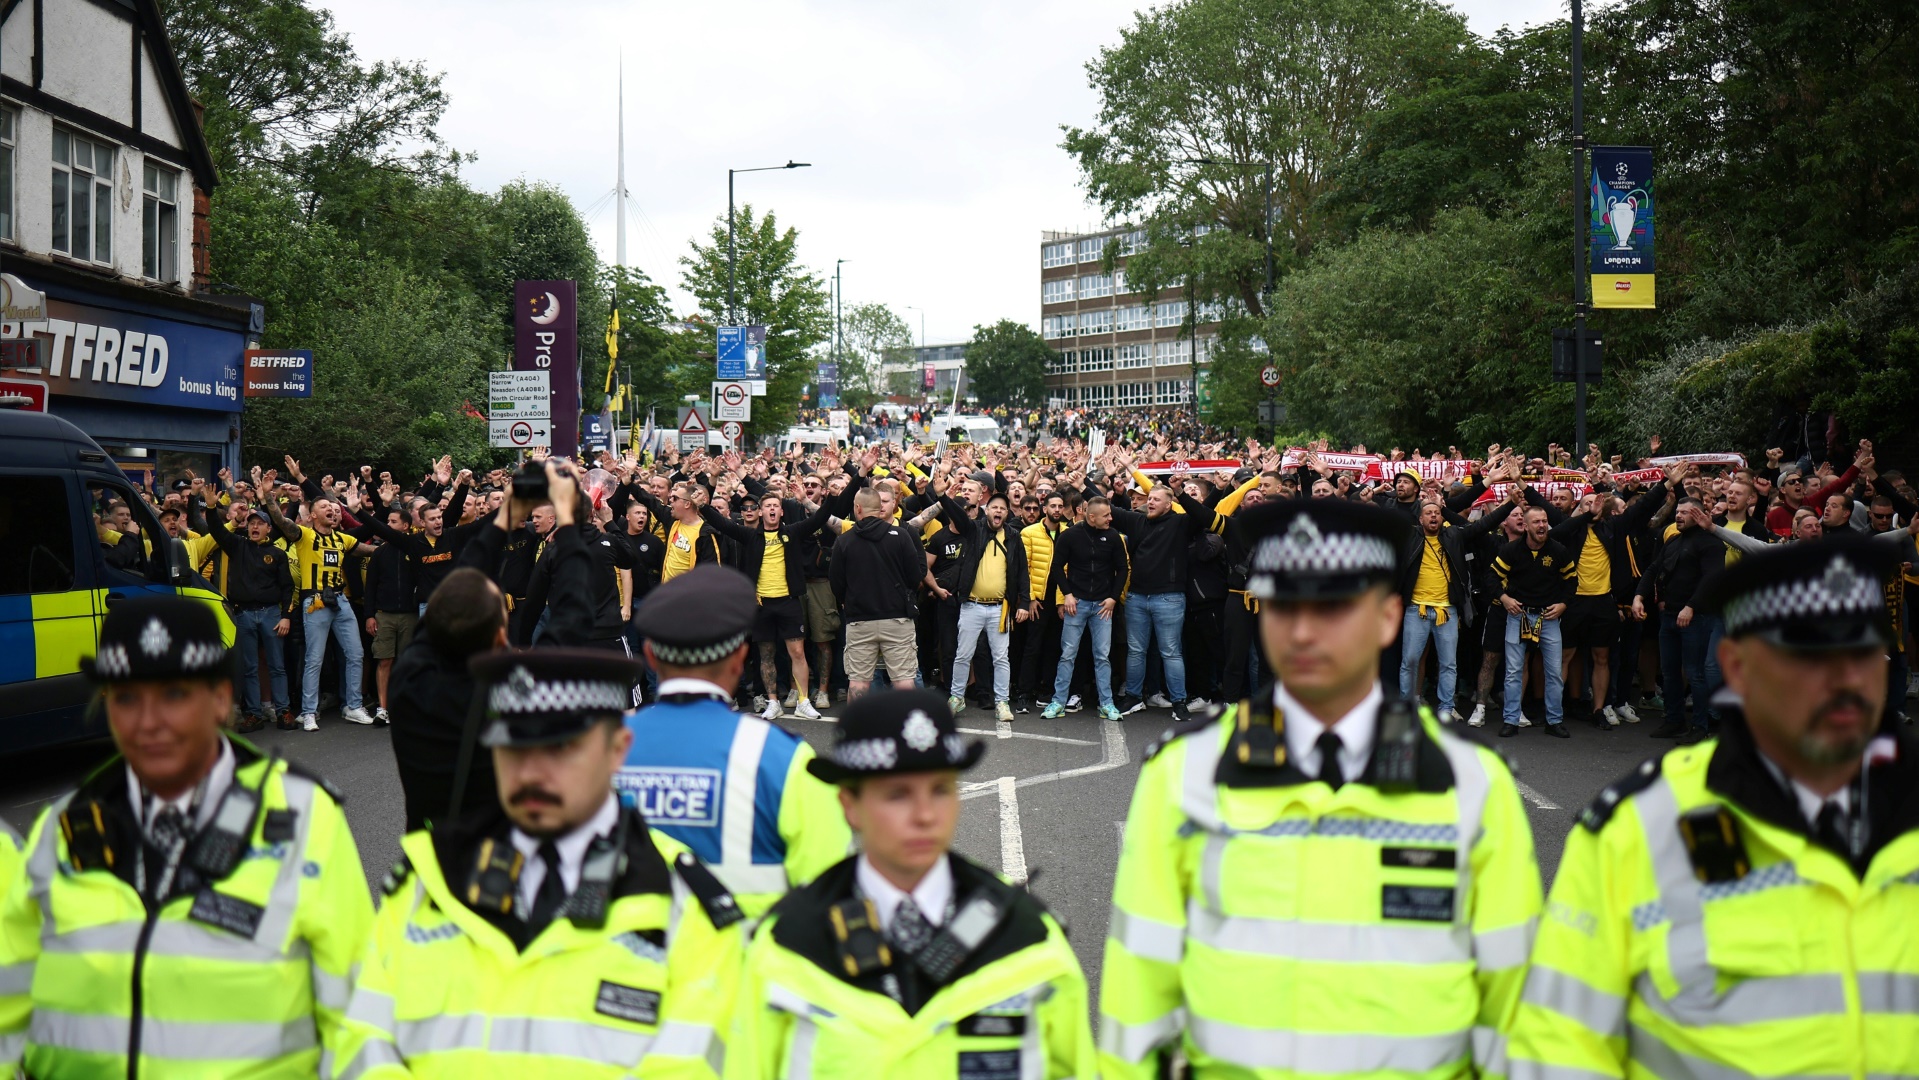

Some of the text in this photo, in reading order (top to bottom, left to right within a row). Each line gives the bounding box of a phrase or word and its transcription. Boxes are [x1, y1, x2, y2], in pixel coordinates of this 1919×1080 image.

[4, 306, 40, 319] World
[0, 318, 168, 388] TFRED
[536, 332, 555, 370] Pre
[250, 357, 305, 367] BETFRED
[224, 365, 237, 380] the
[1264, 371, 1278, 380] 20
[180, 377, 237, 400] bonus king
[284, 382, 305, 391] king
[325, 554, 337, 562] 1&1
